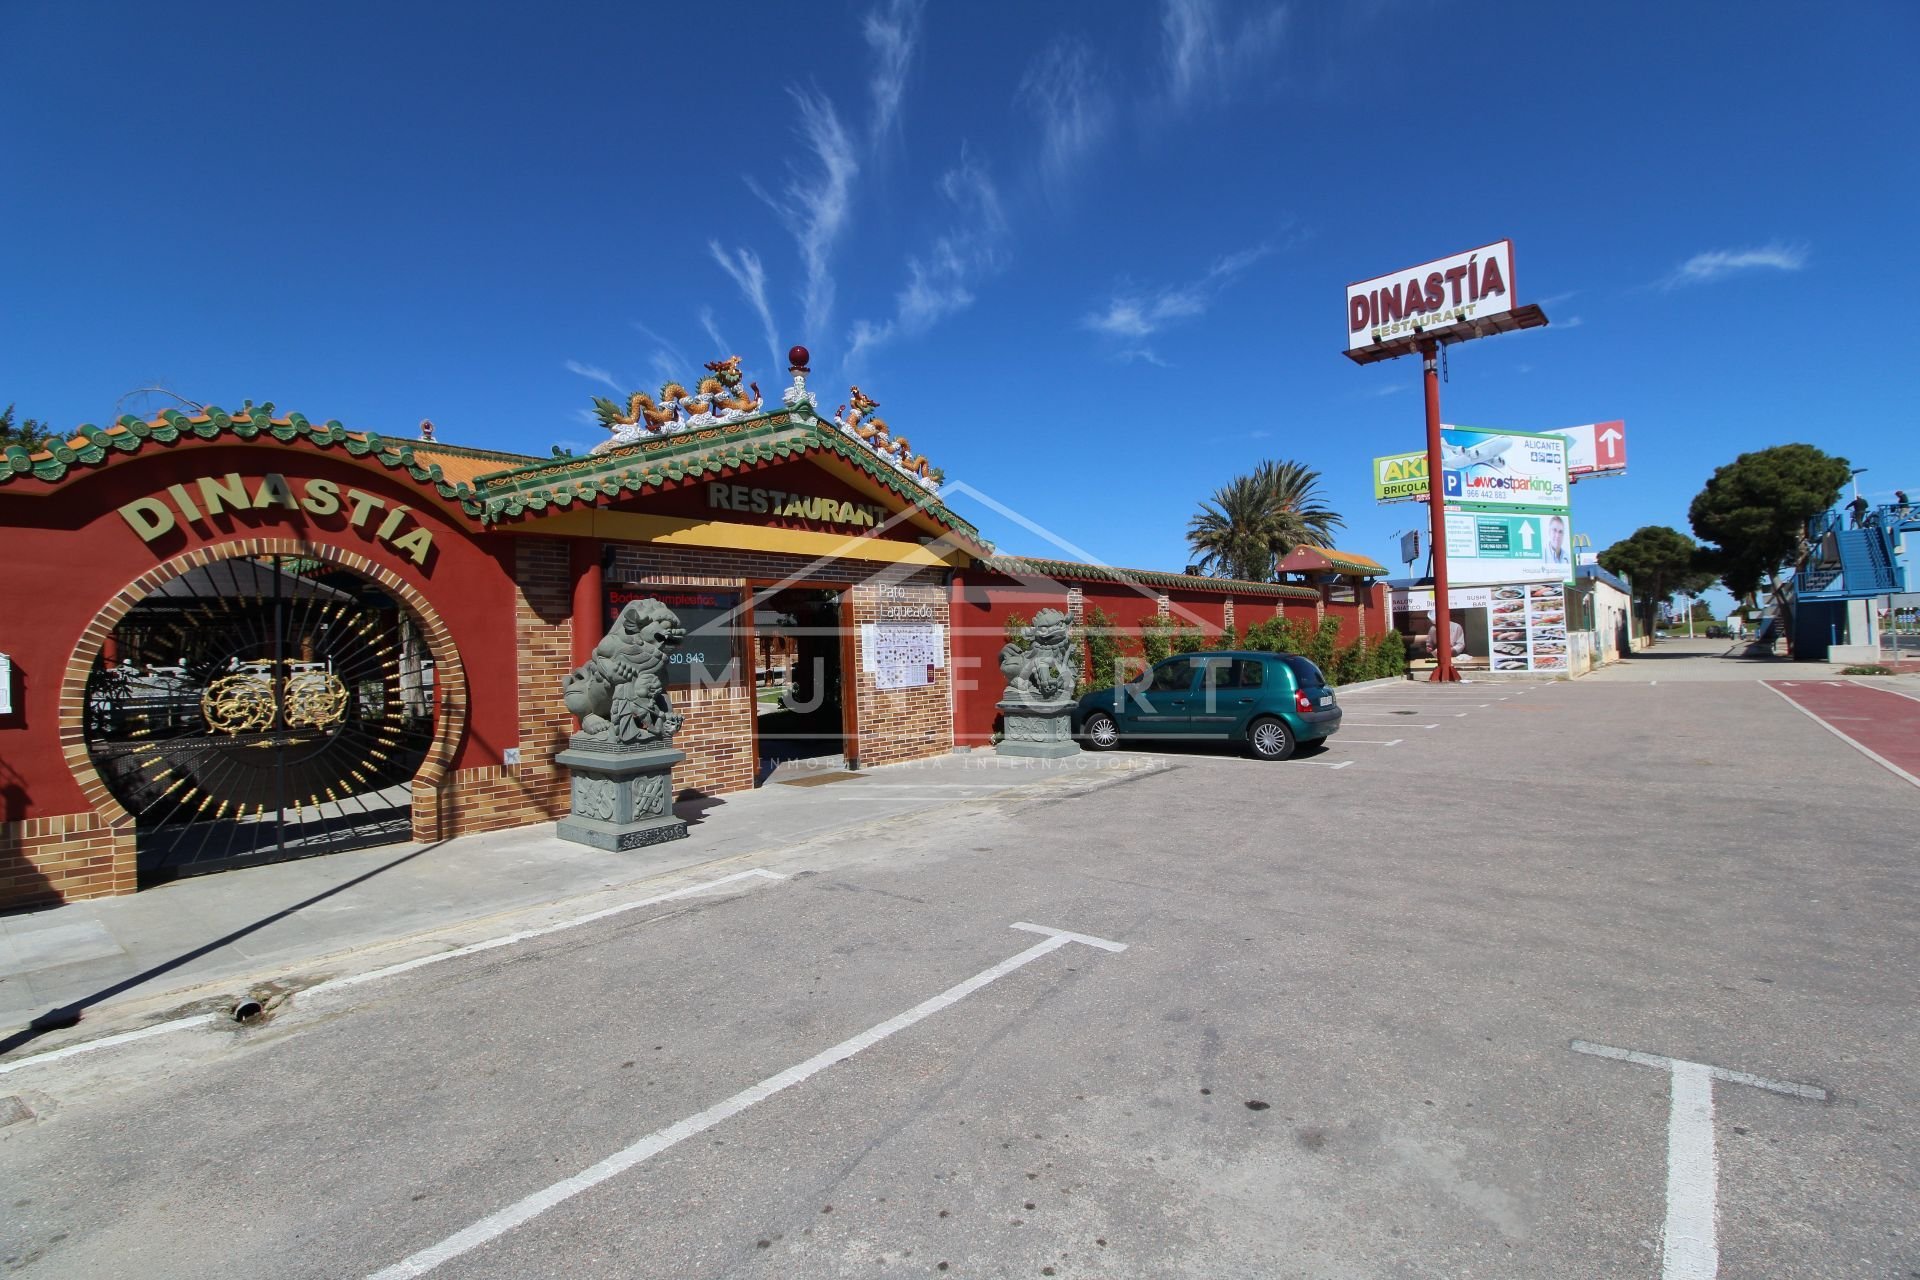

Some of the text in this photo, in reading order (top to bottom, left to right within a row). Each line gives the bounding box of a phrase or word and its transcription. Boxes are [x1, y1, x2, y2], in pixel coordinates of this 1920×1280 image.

[1350, 254, 1505, 333] DINASTÍA
[1371, 304, 1477, 338] RESTAURANT
[1524, 440, 1560, 451] ALICANTE
[1384, 482, 1430, 495] BRICOLA
[1447, 475, 1457, 491] P
[709, 482, 888, 528] RESTAURANT
[880, 583, 905, 598] Pato
[880, 603, 933, 620] Laqueado
[686, 653, 705, 663] 843
